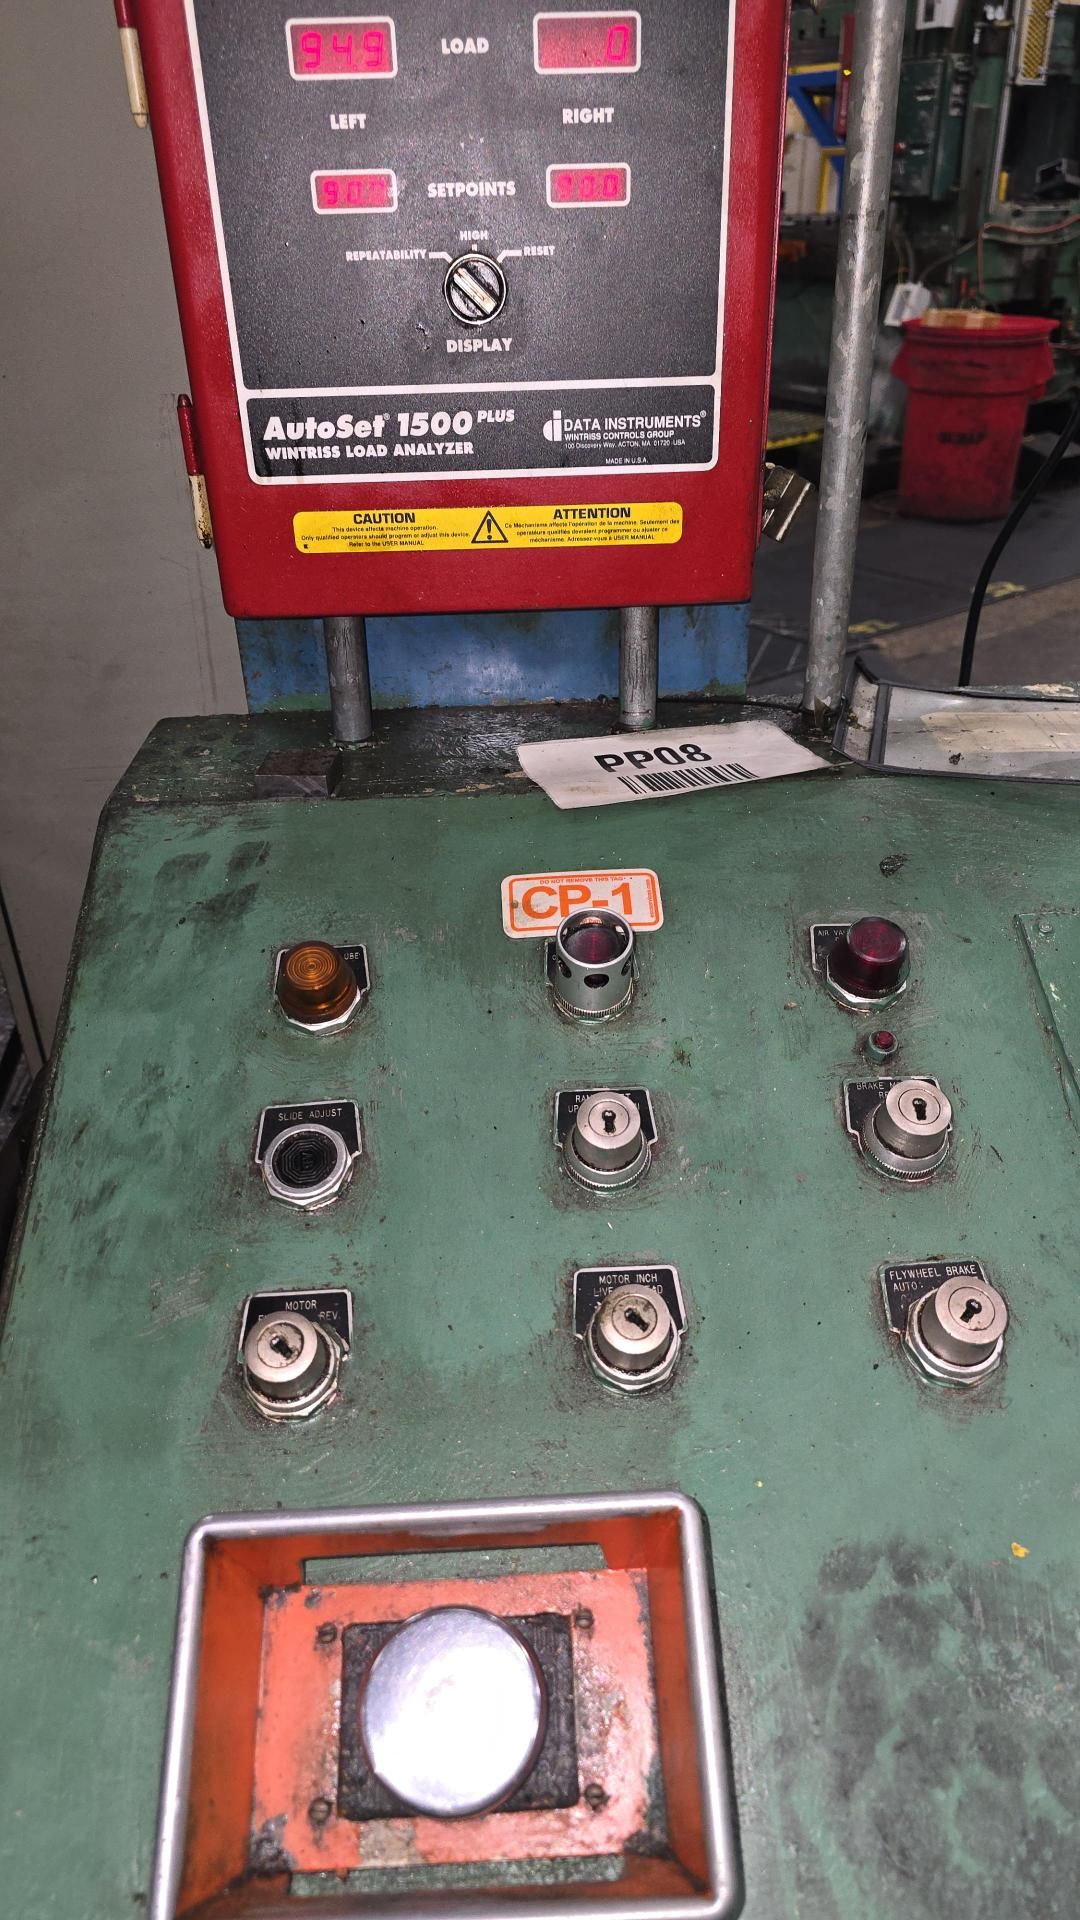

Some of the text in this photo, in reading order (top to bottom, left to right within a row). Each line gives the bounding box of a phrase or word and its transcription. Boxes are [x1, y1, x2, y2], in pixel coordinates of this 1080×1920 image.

[441, 37, 490, 54] LOAD
[330, 114, 366, 130] LEFT
[562, 108, 614, 124] RIGHT
[428, 181, 516, 198] SETPOINTS
[460, 230, 488, 240] HIGH
[346, 250, 427, 262] REPEATABILITY
[524, 246, 555, 256] RESET
[446, 338, 513, 353] DISPLAY
[398, 411, 473, 436] 1500
[477, 409, 515, 423] PLUS
[564, 419, 600, 431] DATA
[564, 430, 674, 441] WINTRISS CONTROLS GROUP
[265, 442, 474, 460] WINTRISS LOAD ANALYZER
[353, 513, 416, 524] CAUTION
[553, 507, 631, 519] ATTENTION
[594, 744, 712, 772] PP08
[522, 883, 633, 919] CP-1
[856, 1082, 885, 1090] BRAKE
[278, 1108, 342, 1121] SLIDE ADJUST
[599, 1273, 658, 1284] MOTOR INCH
[889, 1265, 977, 1280] FLYWHEEL BRAKE
[285, 1300, 317, 1310] MOTOR
[320, 1311, 338, 1320] REV
